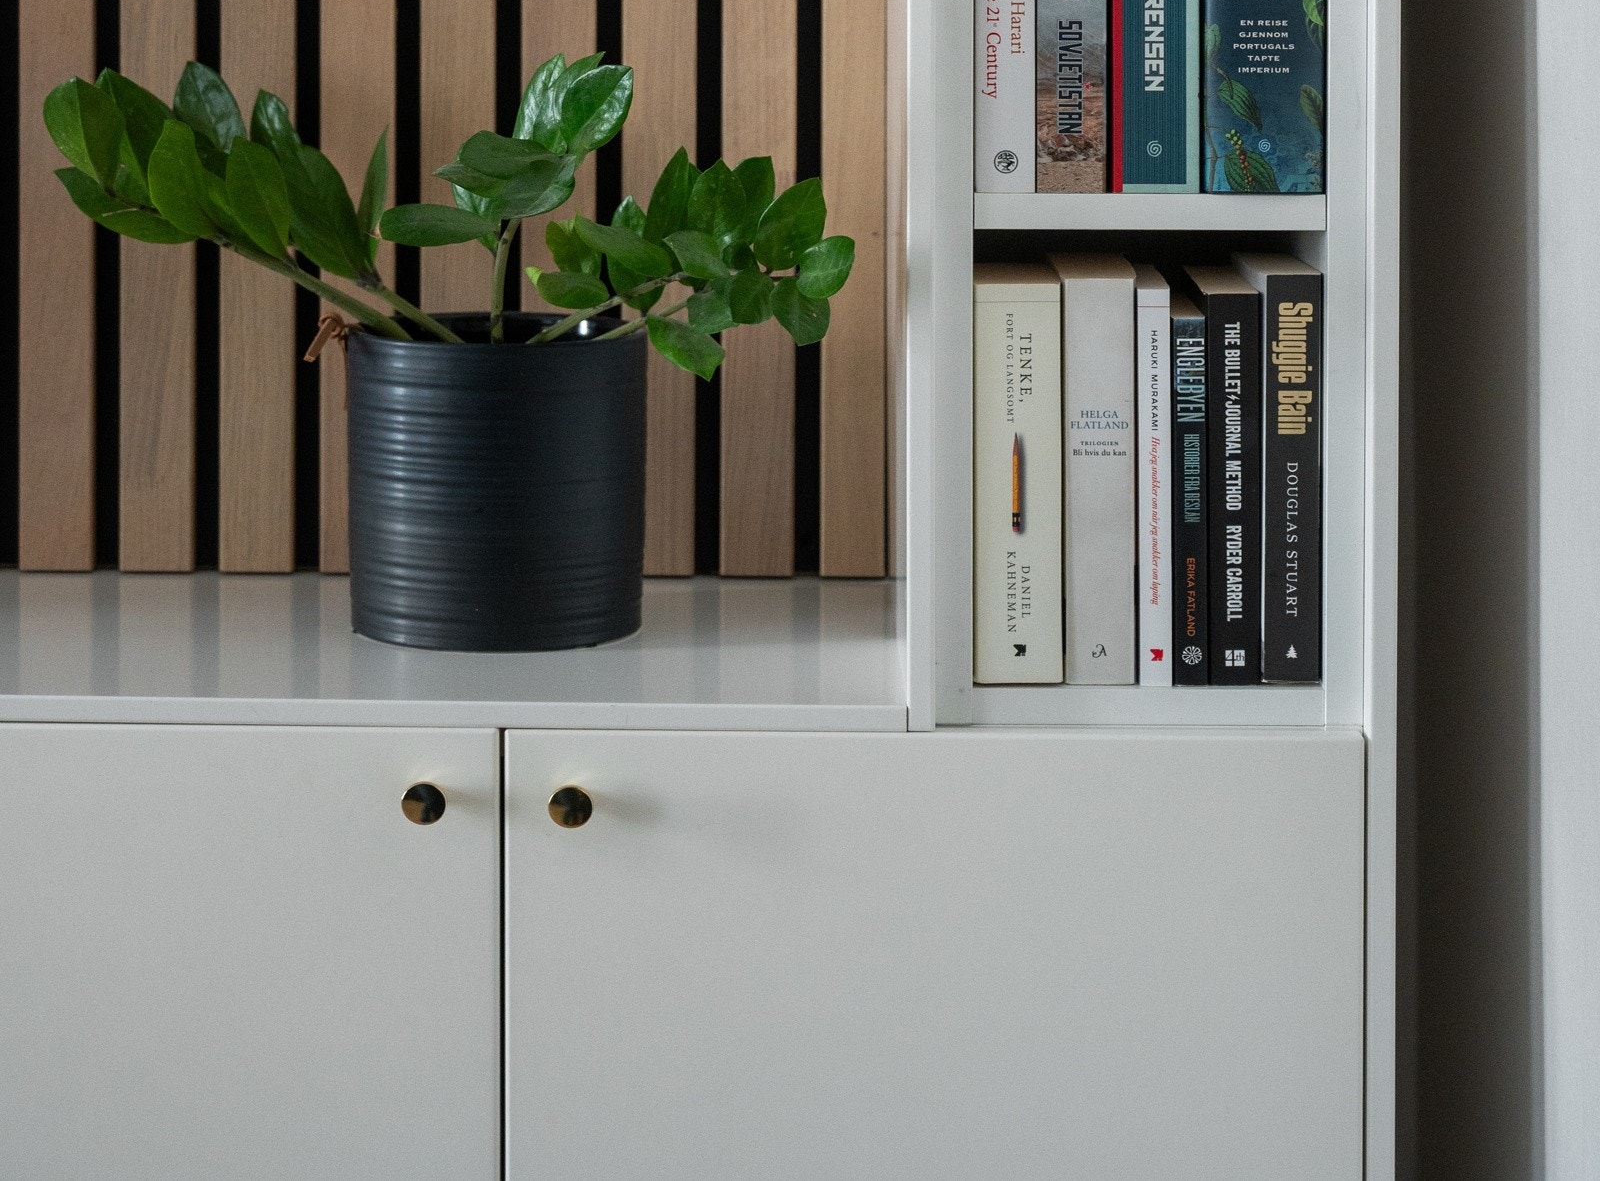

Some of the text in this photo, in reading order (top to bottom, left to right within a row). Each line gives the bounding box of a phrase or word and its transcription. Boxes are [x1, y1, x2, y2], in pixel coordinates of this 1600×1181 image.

[1010, 2, 1025, 54] Harari
[981, 32, 1001, 99] Century
[1058, 20, 1083, 134] SOVJETISTAN
[1006, 313, 1015, 424] FORT OG LANGSOMT
[1018, 333, 1032, 402] TENKE,
[1271, 302, 1314, 435] Shuggie Bain
[1070, 421, 1129, 430] FLATLAND
[1080, 410, 1119, 419] HELGA
[1176, 337, 1206, 523] ENGLEBYEN HISTORIER FRA BESLAN
[1072, 448, 1127, 456] Bli hvis du kan
[1149, 454, 1159, 465] jeg
[1152, 436, 1160, 454] Hva
[1151, 466, 1160, 497] snakker
[1224, 321, 1243, 622] THE BULLET JOURNAL METHOD RYDER CARROLL
[1152, 498, 1158, 509] om
[1152, 511, 1160, 525] når
[1149, 525, 1159, 536] jeg
[1286, 461, 1298, 617] DOUGLAS STUART
[1152, 537, 1161, 567] snakker
[1006, 551, 1016, 633] KAHNEMAN
[1021, 565, 1031, 618] DANIEL
[1150, 581, 1161, 606] løping
[1152, 568, 1158, 579] om
[1186, 557, 1196, 637] ERIKA FATLAND
